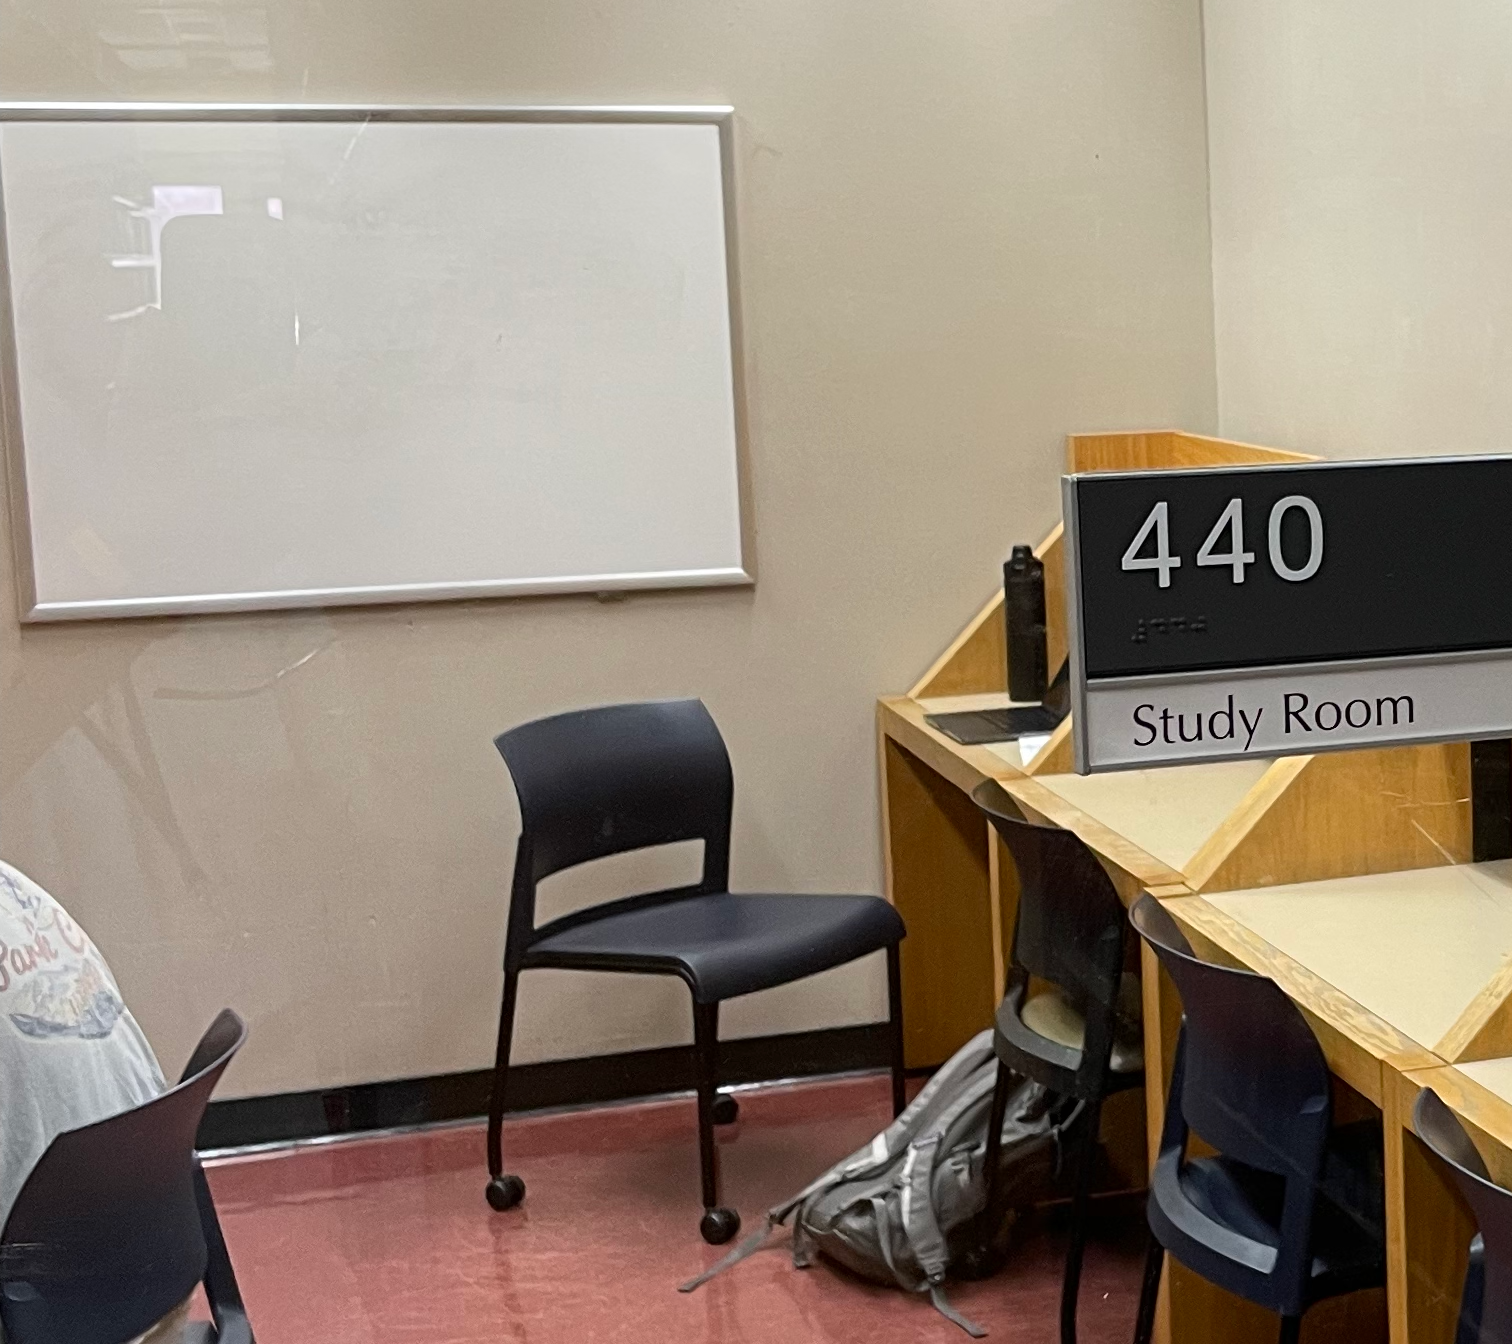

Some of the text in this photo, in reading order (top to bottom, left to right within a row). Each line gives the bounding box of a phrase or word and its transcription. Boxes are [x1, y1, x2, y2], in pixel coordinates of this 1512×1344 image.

[1120, 494, 1325, 589] 440
[1131, 692, 1416, 752] Study Room
